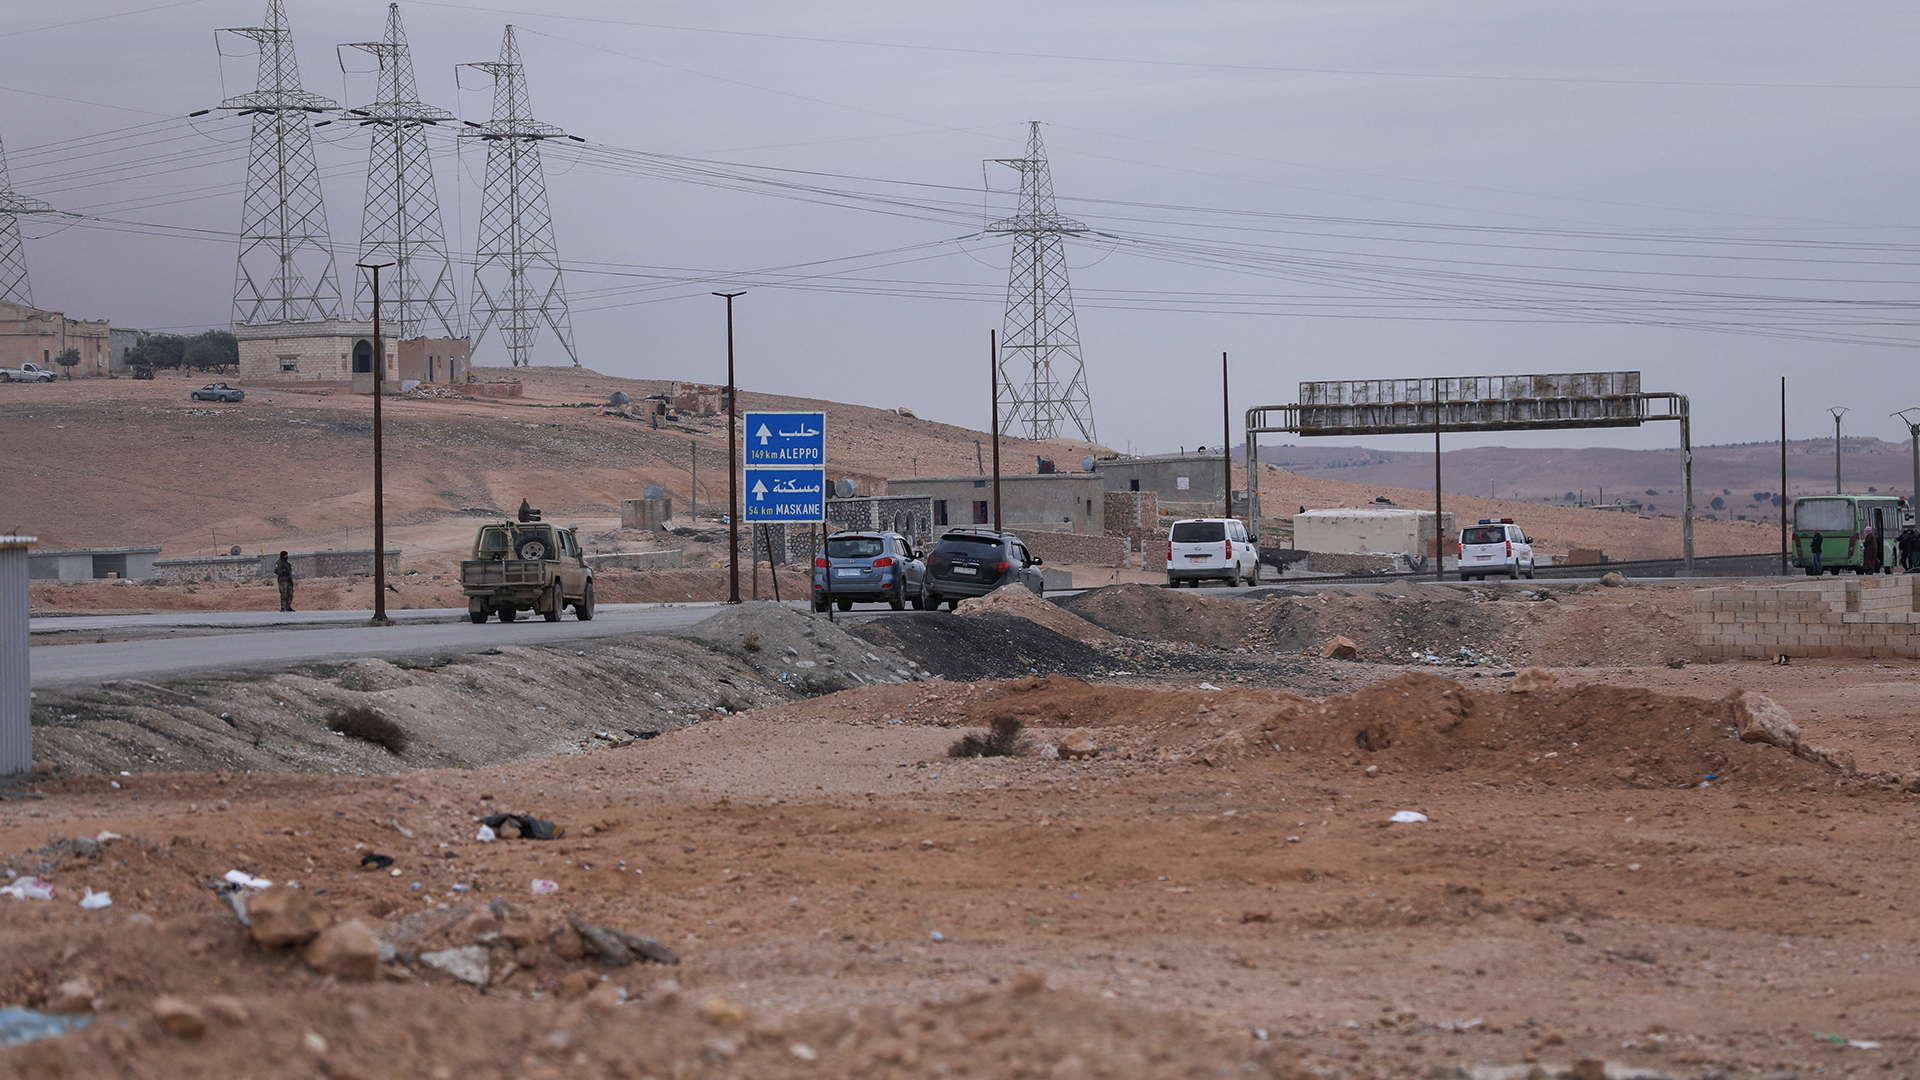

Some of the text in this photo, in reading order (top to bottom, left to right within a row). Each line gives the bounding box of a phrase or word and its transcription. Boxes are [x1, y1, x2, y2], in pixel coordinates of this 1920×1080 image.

[778, 423, 820, 441] حلب
[751, 448, 818, 459] 149 km ALEPPO
[772, 479, 820, 493] مسكنة
[749, 504, 820, 515] 54 km MASKANE
